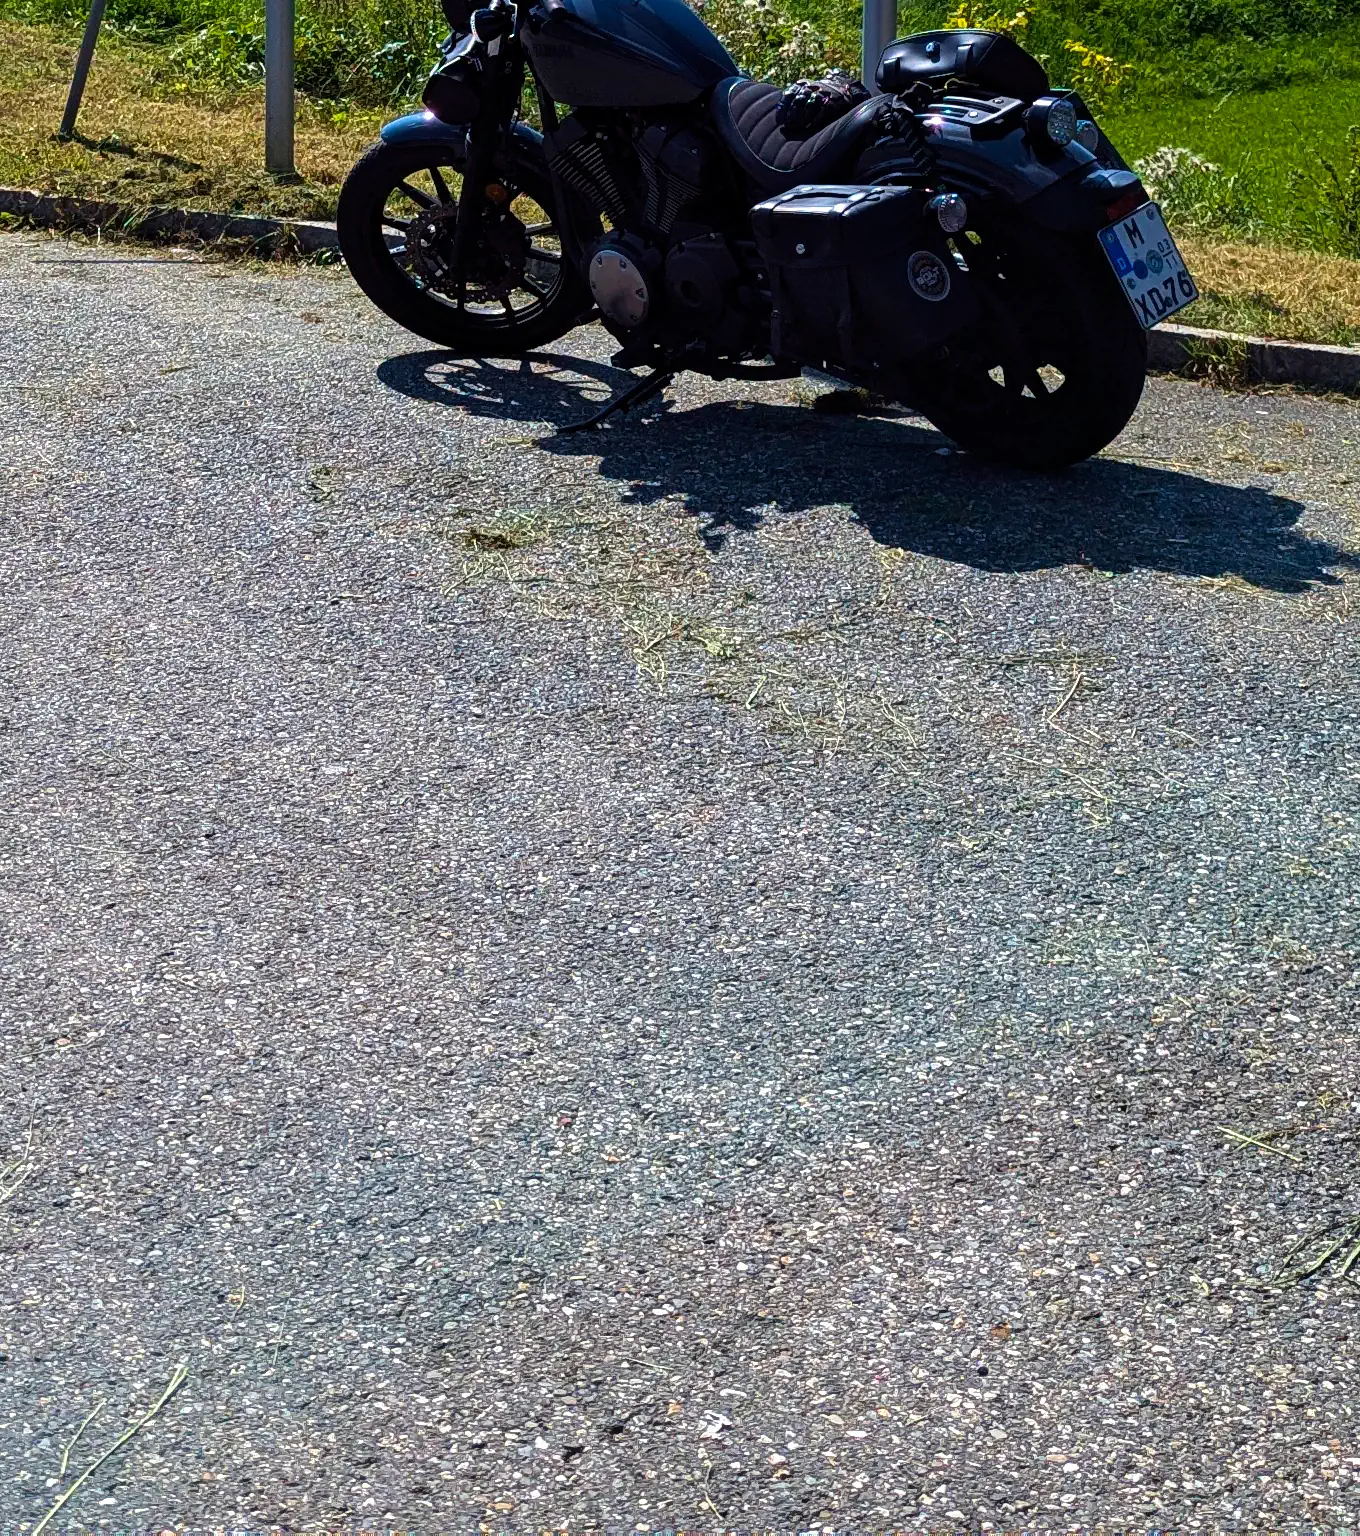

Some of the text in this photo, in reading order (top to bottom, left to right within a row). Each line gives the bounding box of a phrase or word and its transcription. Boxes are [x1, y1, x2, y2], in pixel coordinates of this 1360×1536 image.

[1123, 218, 1144, 249] M
[1157, 238, 1171, 253] 03
[1117, 257, 1127, 270] D
[1134, 269, 1193, 324] XD 76
